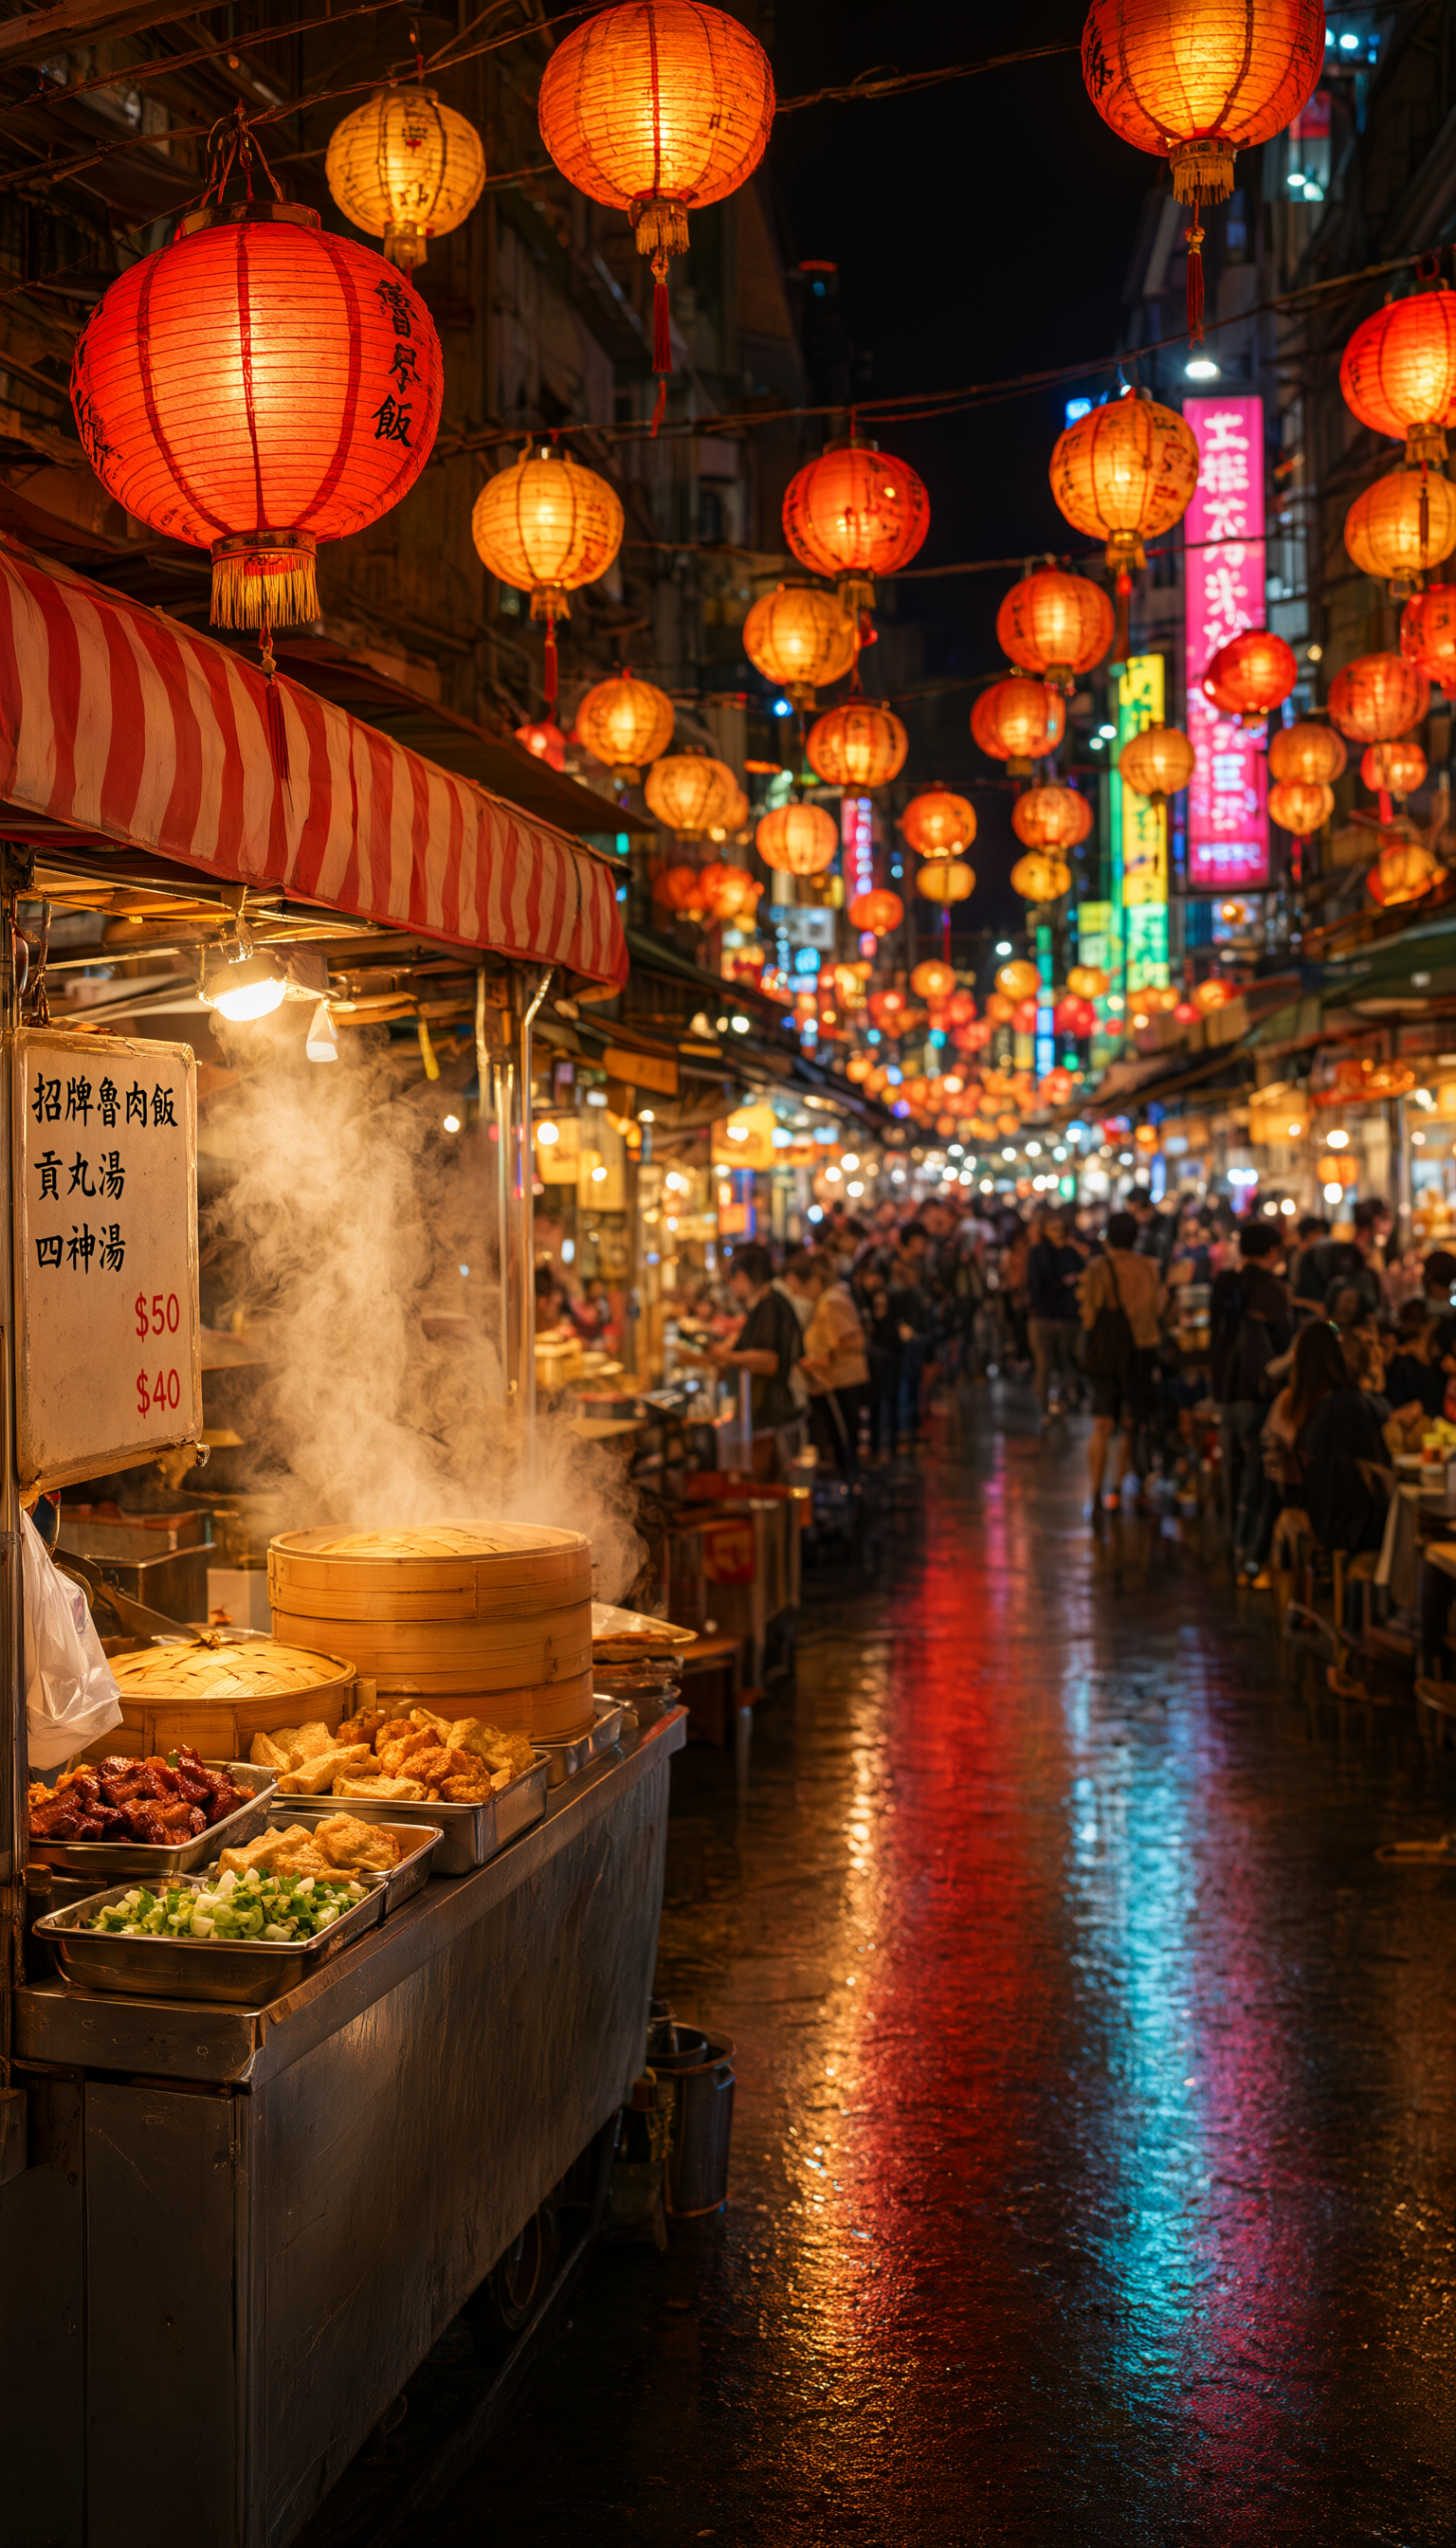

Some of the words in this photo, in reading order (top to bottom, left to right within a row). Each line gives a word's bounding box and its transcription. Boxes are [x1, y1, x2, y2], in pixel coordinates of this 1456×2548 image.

[32, 1072, 178, 1128] 招牌魯肉飯
[33, 1150, 126, 1201] 貢丸湯
[35, 1223, 126, 1274] 四神湯
[135, 1292, 180, 1342] $50
[136, 1369, 181, 1418] $40
